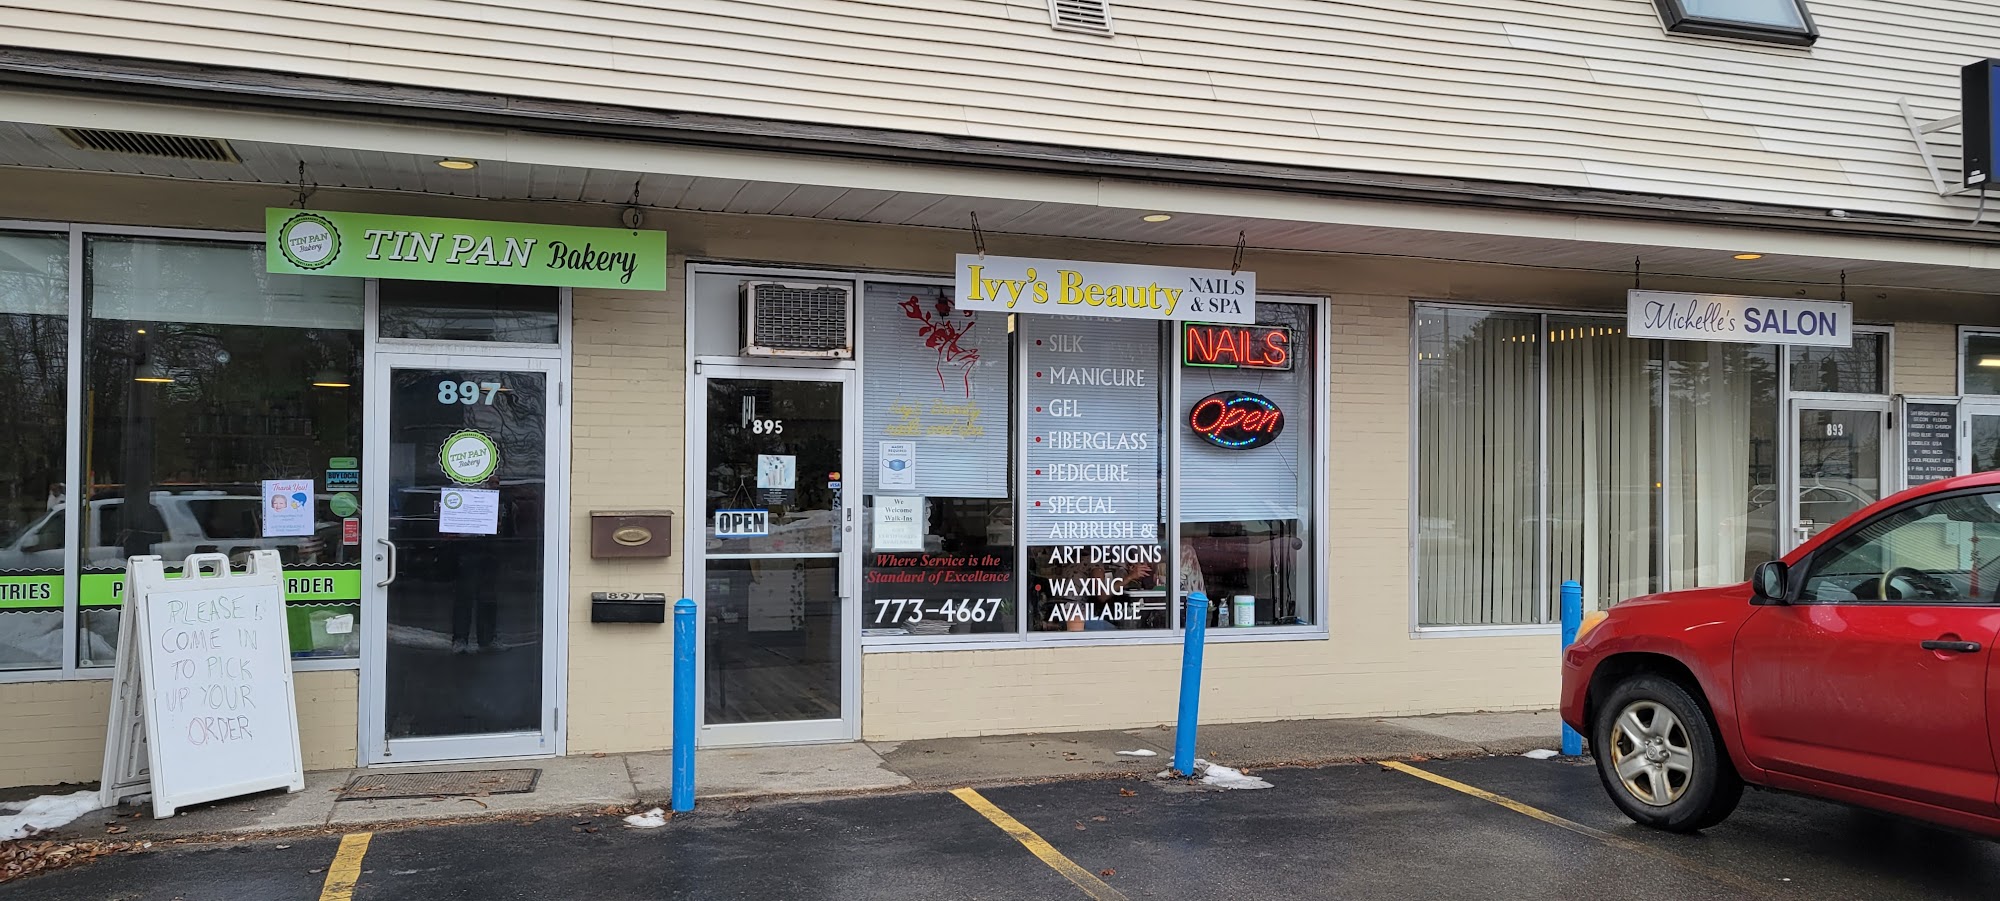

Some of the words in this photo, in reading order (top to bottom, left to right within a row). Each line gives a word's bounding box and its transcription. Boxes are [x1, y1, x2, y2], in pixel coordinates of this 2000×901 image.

[290, 237, 307, 247] TIN
[308, 233, 328, 243] PAN
[363, 229, 443, 263] TIN
[446, 234, 538, 267] PAN
[546, 240, 639, 284] Bakery
[967, 264, 1049, 309] Ivy's
[1057, 269, 1183, 316] Beauty
[1188, 276, 1246, 296] NAILS
[1190, 297, 1204, 313] &
[1209, 298, 1242, 315] SPA
[1643, 299, 1736, 333] Michelle's
[1744, 307, 1837, 337] SALON
[1049, 335, 1084, 352] SILK
[1188, 327, 1288, 365] NAILS
[1049, 367, 1146, 387] MANICURE
[438, 380, 501, 405] 897
[1049, 399, 1082, 418] GEL
[1192, 399, 1280, 437] Open
[752, 419, 783, 434] 895
[1826, 423, 1843, 436] 893
[1048, 431, 1147, 451] FIBERGLASS
[450, 452, 467, 462] TIN
[468, 449, 487, 459] PAN
[1049, 463, 1129, 482] PEDICURE
[272, 483, 292, 491] Thank
[292, 483, 308, 492] You!
[1048, 496, 1116, 513] SPECIAL
[719, 513, 765, 533] OPEN
[1049, 521, 1134, 539] AIRBRUSH
[1141, 523, 1155, 539] &
[876, 554, 917, 567] Where
[920, 554, 965, 567] Service
[968, 554, 978, 566] is
[981, 554, 1000, 566] the
[1048, 545, 1084, 564] ART
[1091, 545, 1162, 564] DESIGNS
[283, 578, 333, 593] RDER
[867, 570, 925, 583] Standard
[928, 570, 944, 586] of
[944, 570, 1010, 582] Excellence
[1048, 577, 1124, 597] WAXING
[167, 595, 245, 625] PLEASE
[874, 598, 1002, 623] 773-4667
[1048, 602, 1141, 622] AVAILABLE
[161, 628, 221, 653] COME
[238, 628, 258, 650] IN
[171, 659, 196, 680] TO
[206, 656, 252, 680] PICK
[166, 687, 190, 712] UP
[200, 684, 256, 711] YOUR
[188, 715, 253, 745] ORDER
